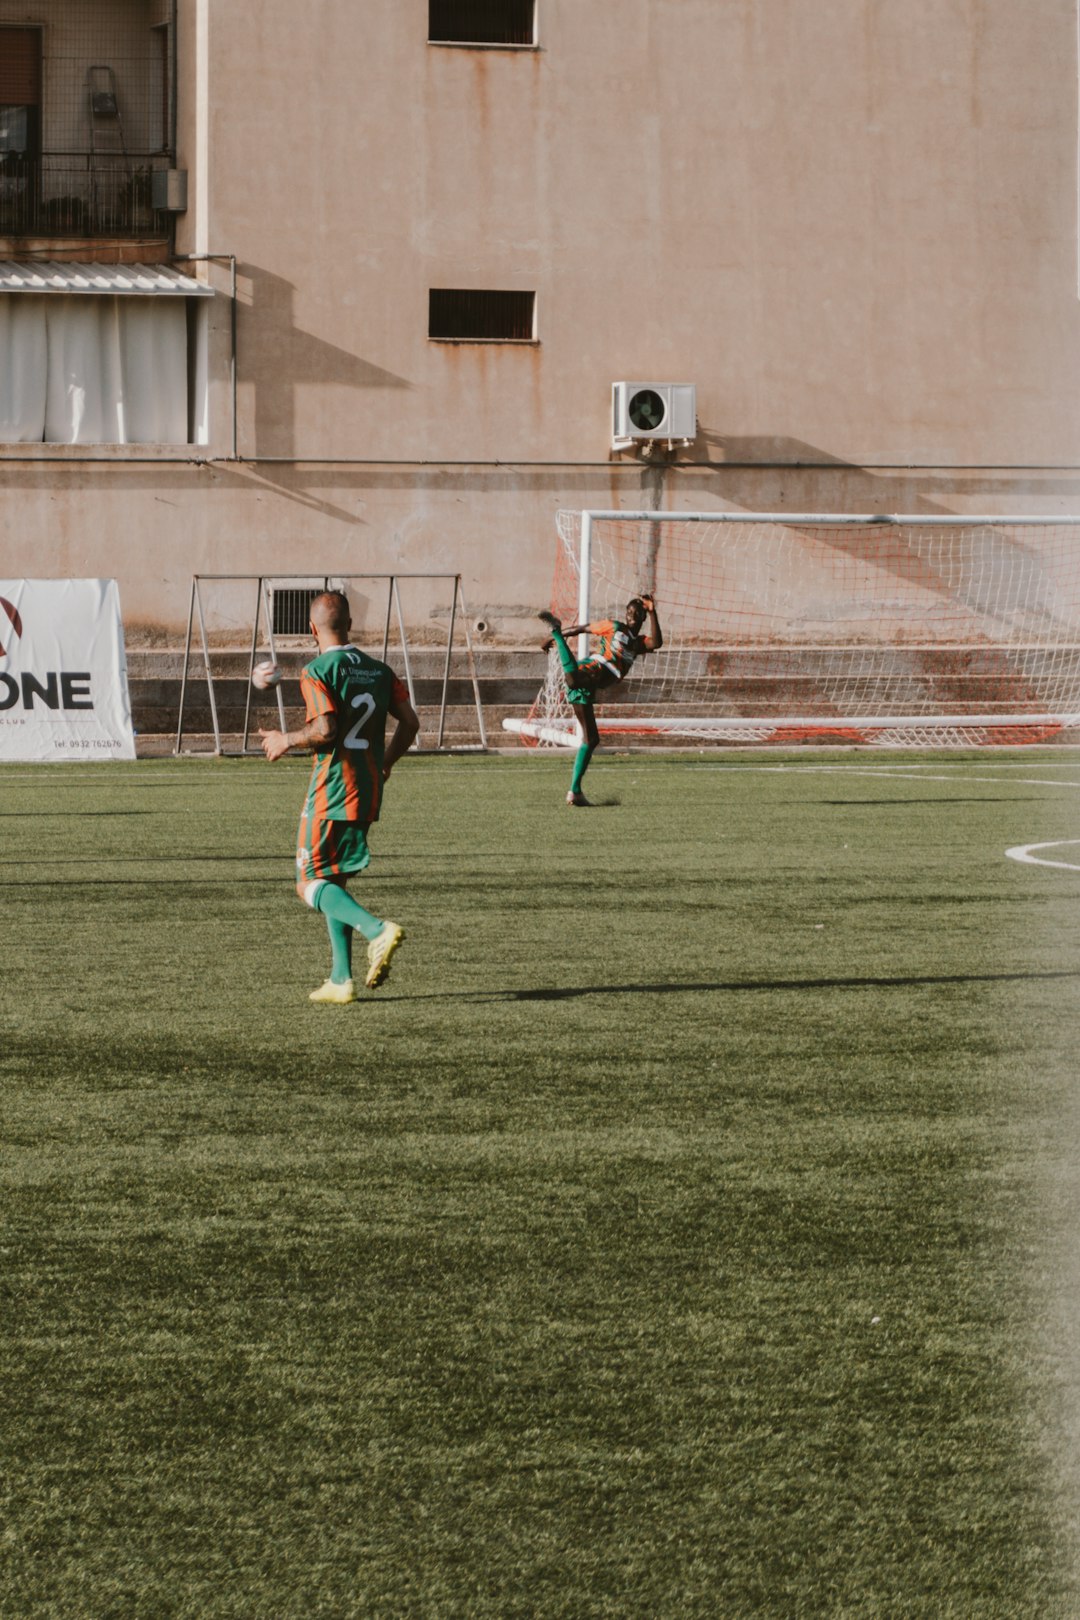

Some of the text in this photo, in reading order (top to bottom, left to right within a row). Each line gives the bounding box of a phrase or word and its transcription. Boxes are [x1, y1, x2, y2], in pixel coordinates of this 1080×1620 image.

[343, 692, 376, 750] 2
[70, 740, 90, 748] 0932
[92, 739, 122, 748] 762676
